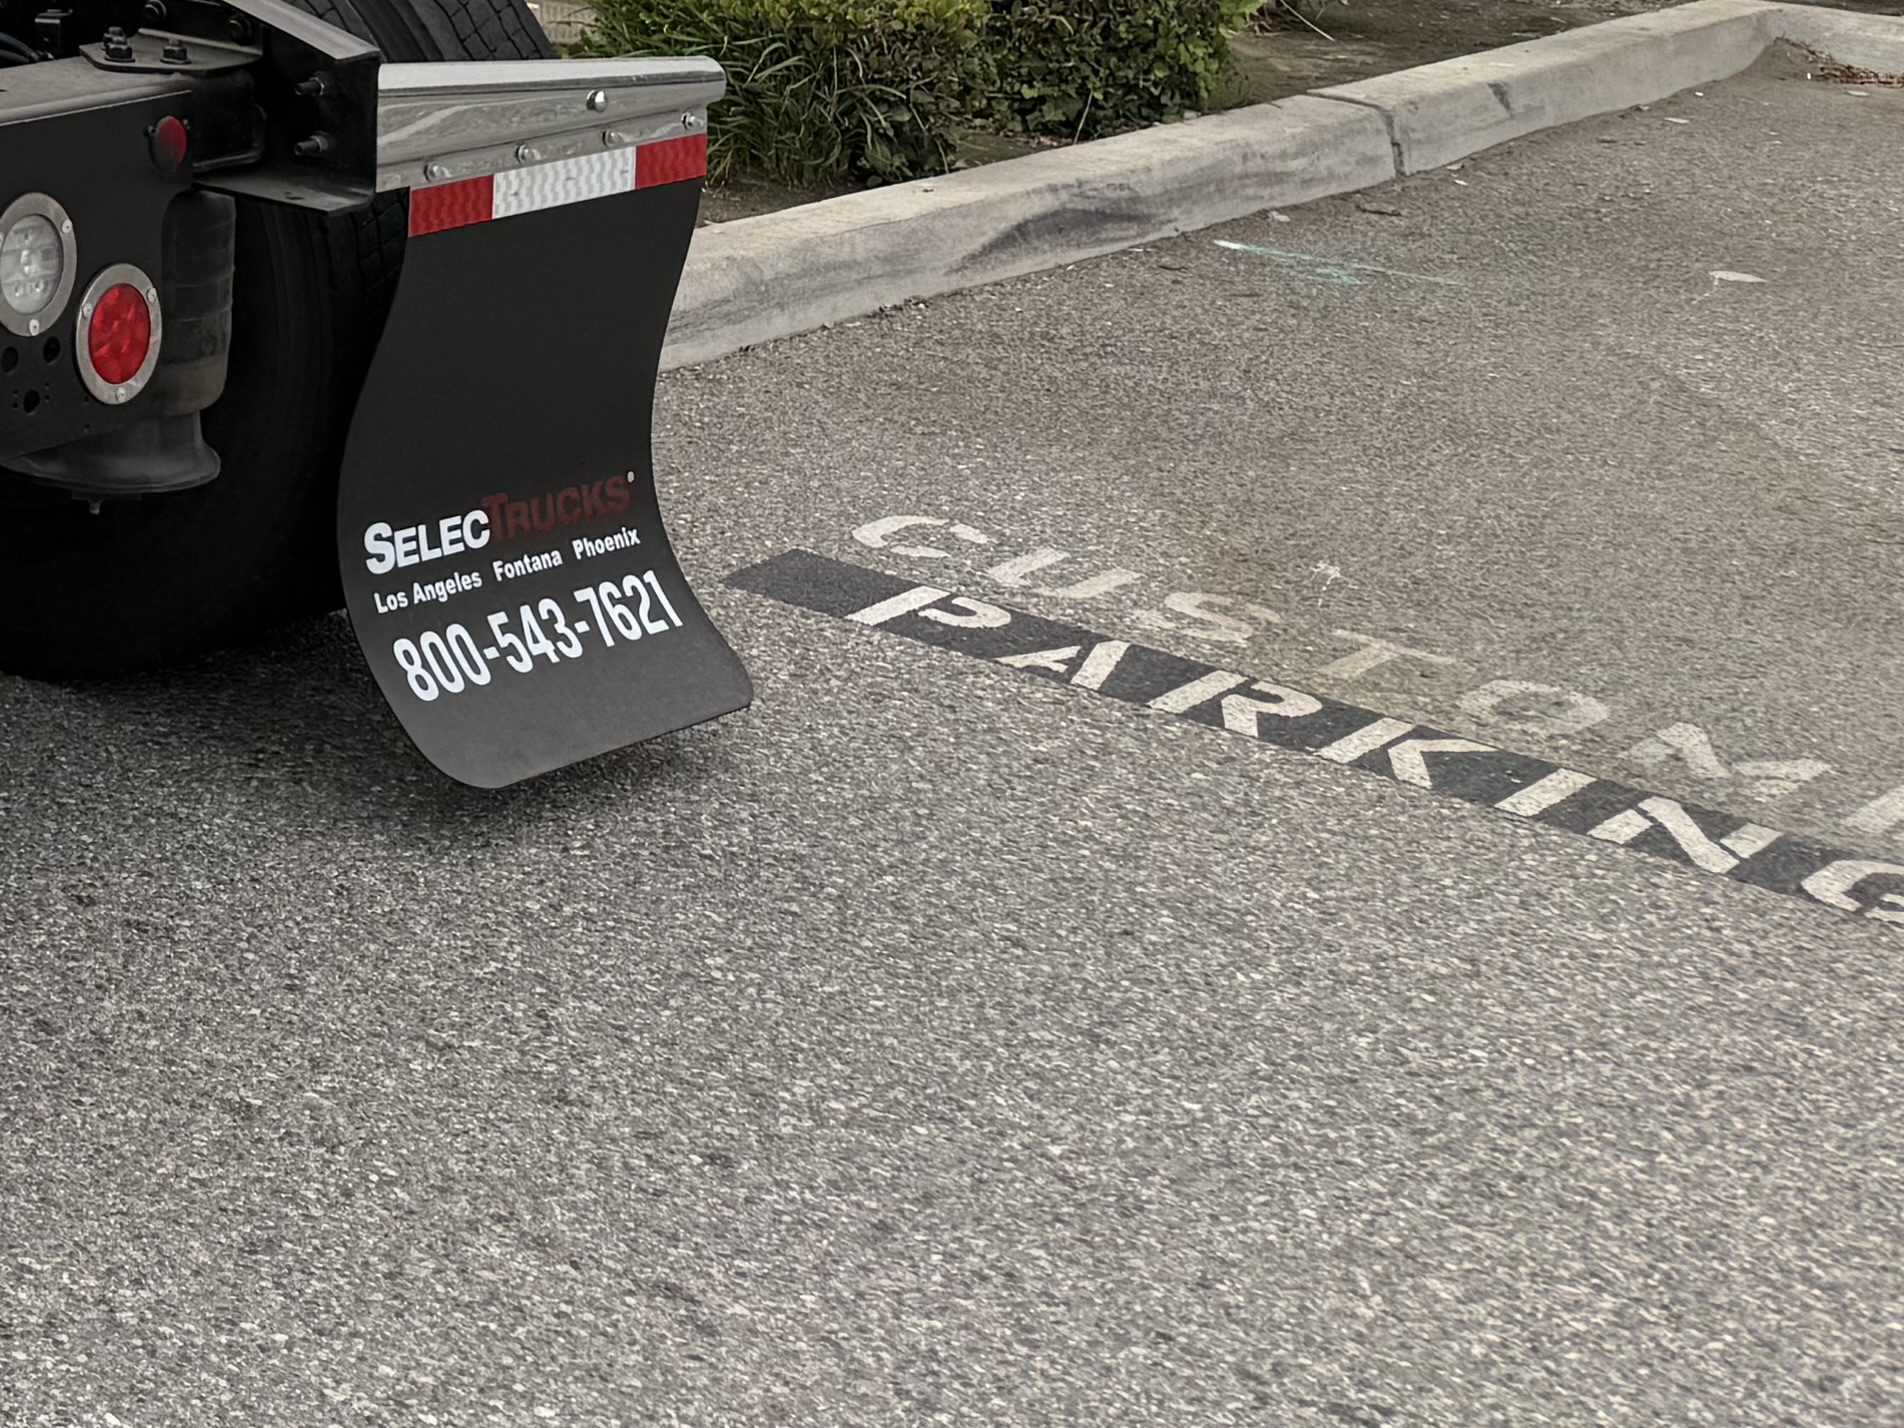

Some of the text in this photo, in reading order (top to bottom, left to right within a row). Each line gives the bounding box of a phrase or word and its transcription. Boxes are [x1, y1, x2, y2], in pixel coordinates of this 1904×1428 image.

[364, 477, 631, 575] SELECTRUCKS
[373, 526, 641, 614] Los Angeles Fontana Phoenix
[393, 569, 684, 702] 800-543-7621
[852, 514, 1904, 834] CUSTOM
